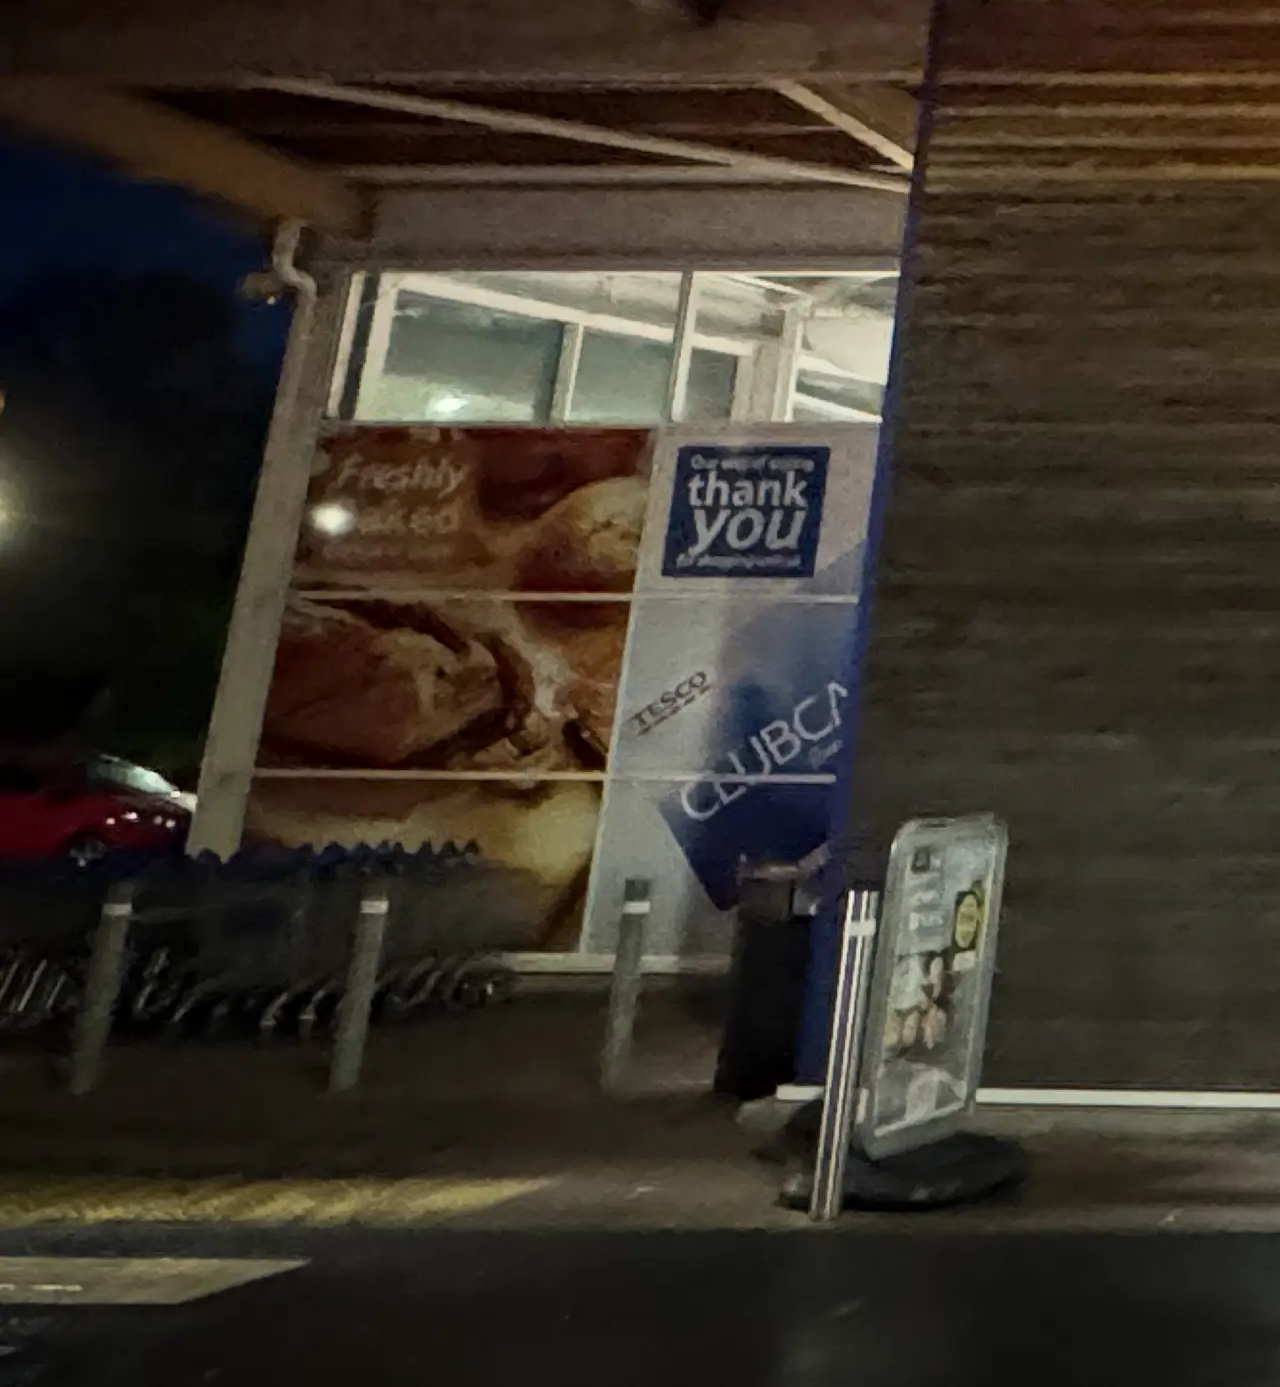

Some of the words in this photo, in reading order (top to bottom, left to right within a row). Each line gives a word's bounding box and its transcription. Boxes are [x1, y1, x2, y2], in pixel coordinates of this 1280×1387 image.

[688, 471, 808, 507] thank
[688, 508, 808, 556] you
[633, 671, 708, 730] TESCO
